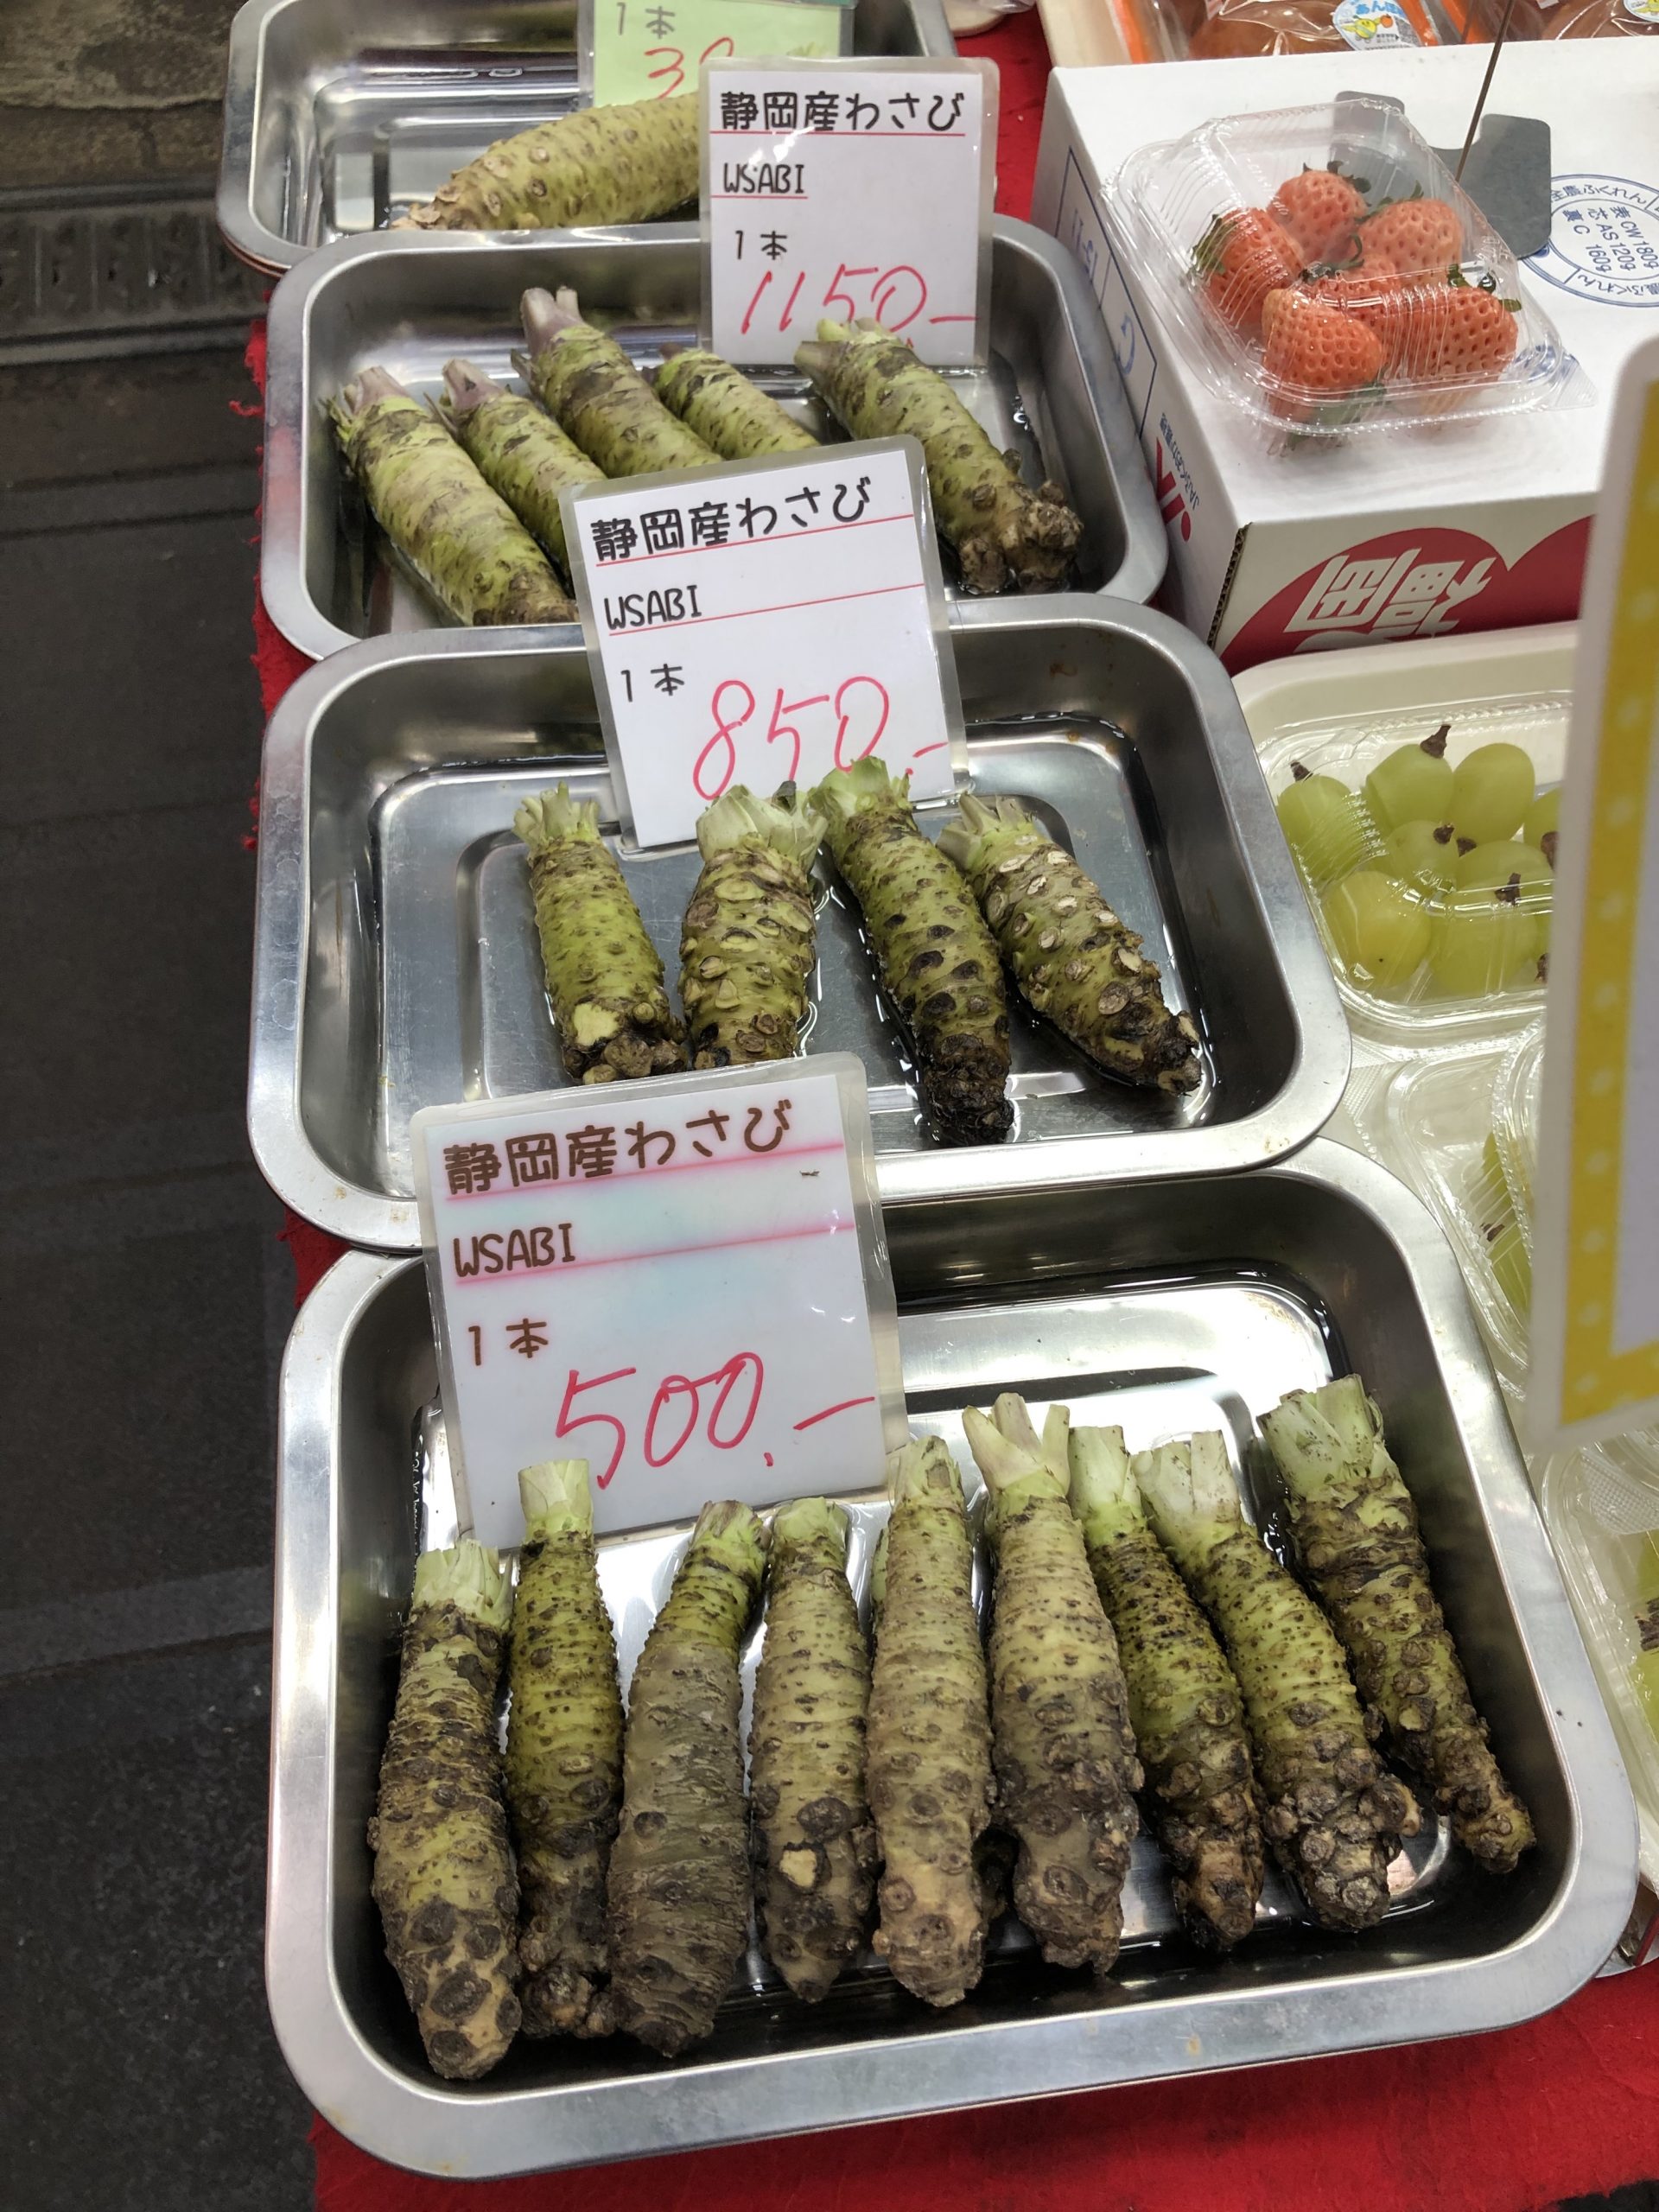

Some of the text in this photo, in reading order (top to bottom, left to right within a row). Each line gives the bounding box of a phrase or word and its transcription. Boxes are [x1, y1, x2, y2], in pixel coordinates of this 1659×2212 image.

[644, 36, 734, 99] 3
[720, 90, 965, 131] 静岡産わさび
[723, 162, 805, 194] WSABI
[590, 476, 872, 562] 静岡産わさび
[604, 584, 702, 631] WSABI
[442, 1099, 792, 1196] 静岡産わさび
[453, 1223, 576, 1279] WSABI
